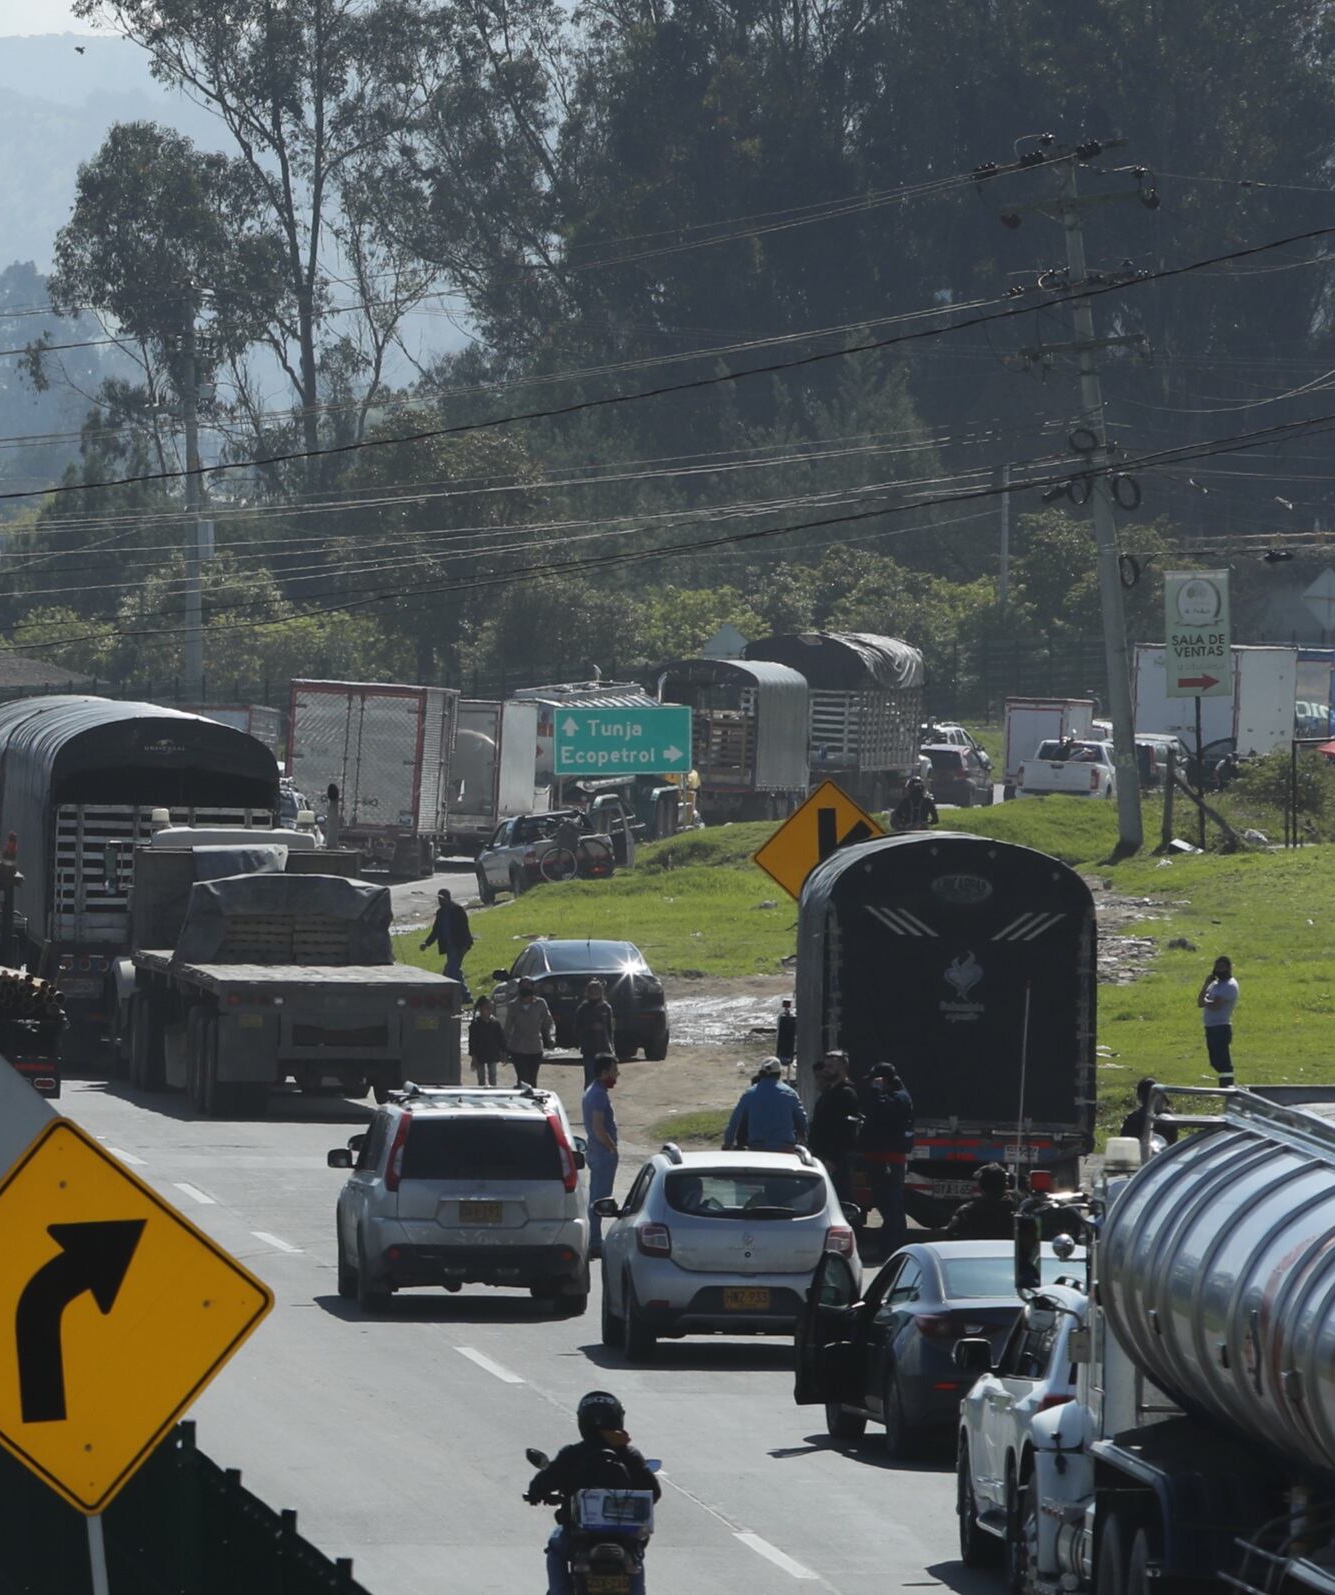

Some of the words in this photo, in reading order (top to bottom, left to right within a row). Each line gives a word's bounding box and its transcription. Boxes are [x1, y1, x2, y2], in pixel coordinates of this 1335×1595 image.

[1171, 634, 1205, 646] SALA
[1208, 633, 1226, 645] DE
[1173, 645, 1225, 658] VENTAS
[587, 719, 643, 741] Tunja
[560, 746, 655, 767] Ecopetrol
